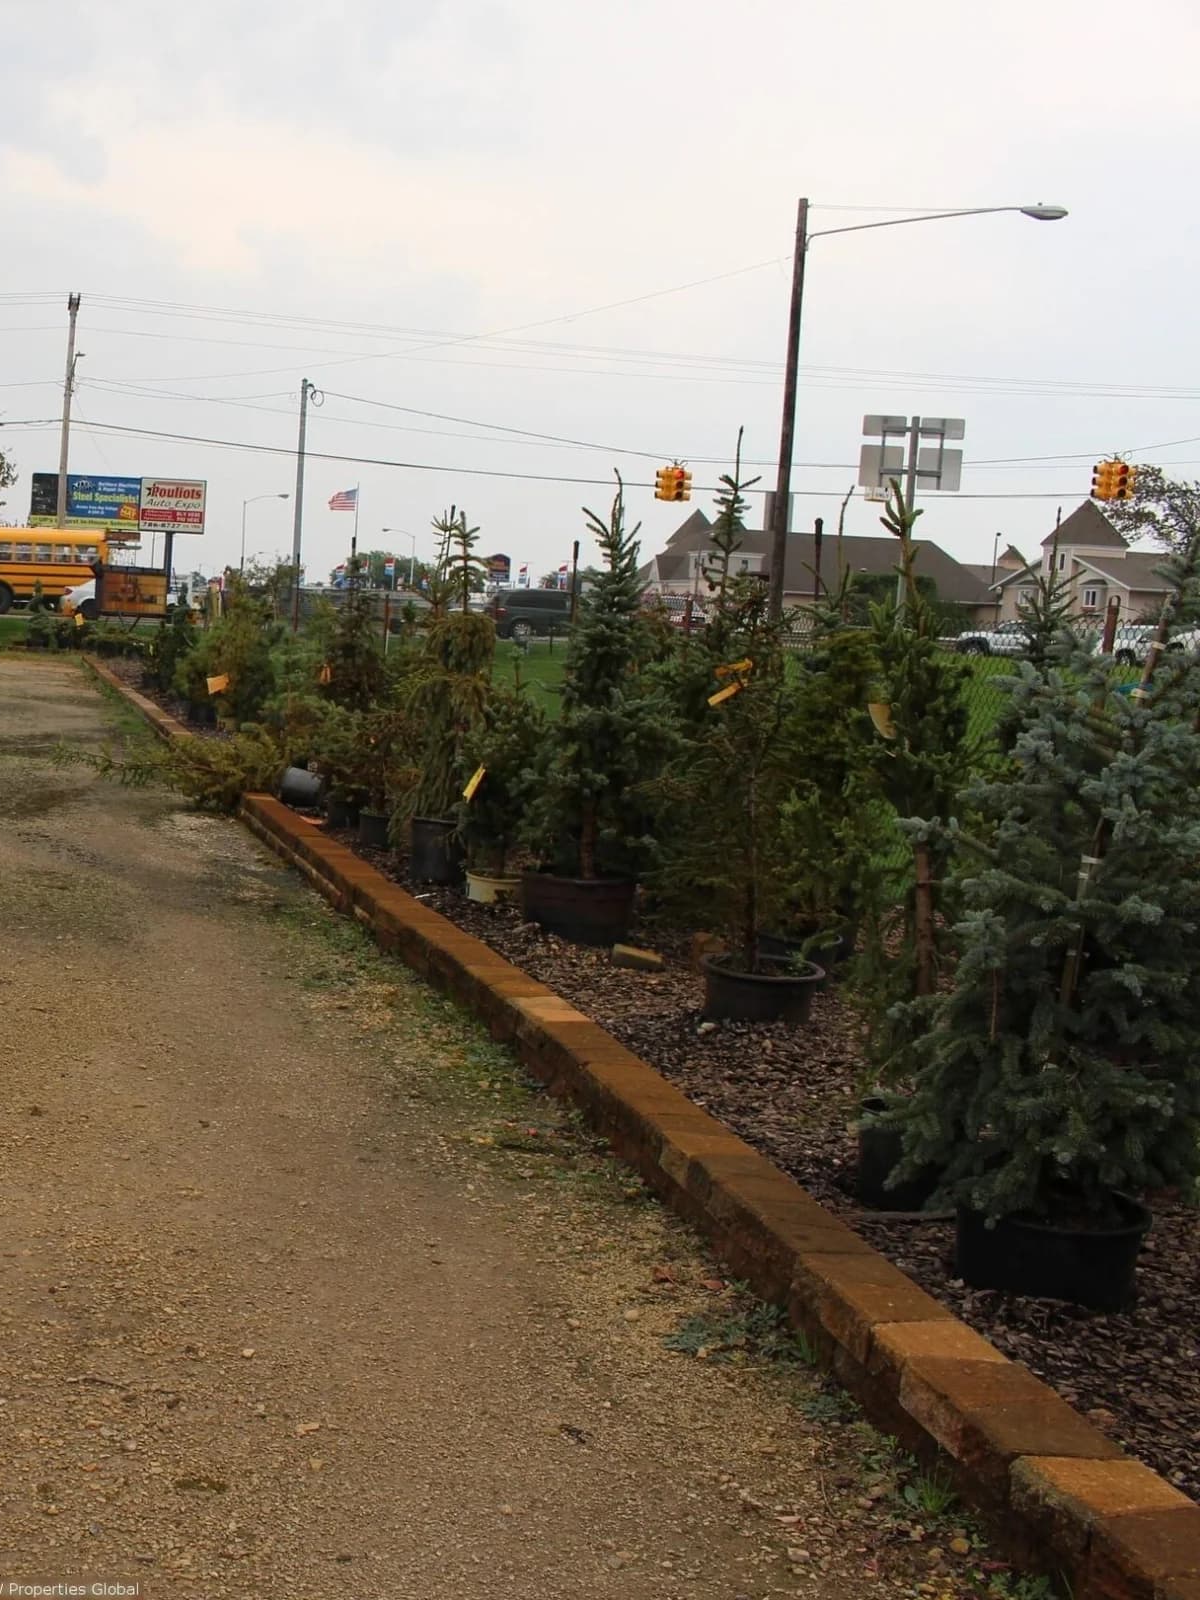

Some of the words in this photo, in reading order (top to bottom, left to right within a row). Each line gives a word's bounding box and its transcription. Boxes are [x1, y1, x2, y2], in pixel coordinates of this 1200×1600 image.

[73, 491, 93, 501] Steel
[146, 499, 171, 507] Auto
[175, 500, 201, 509] Expo
